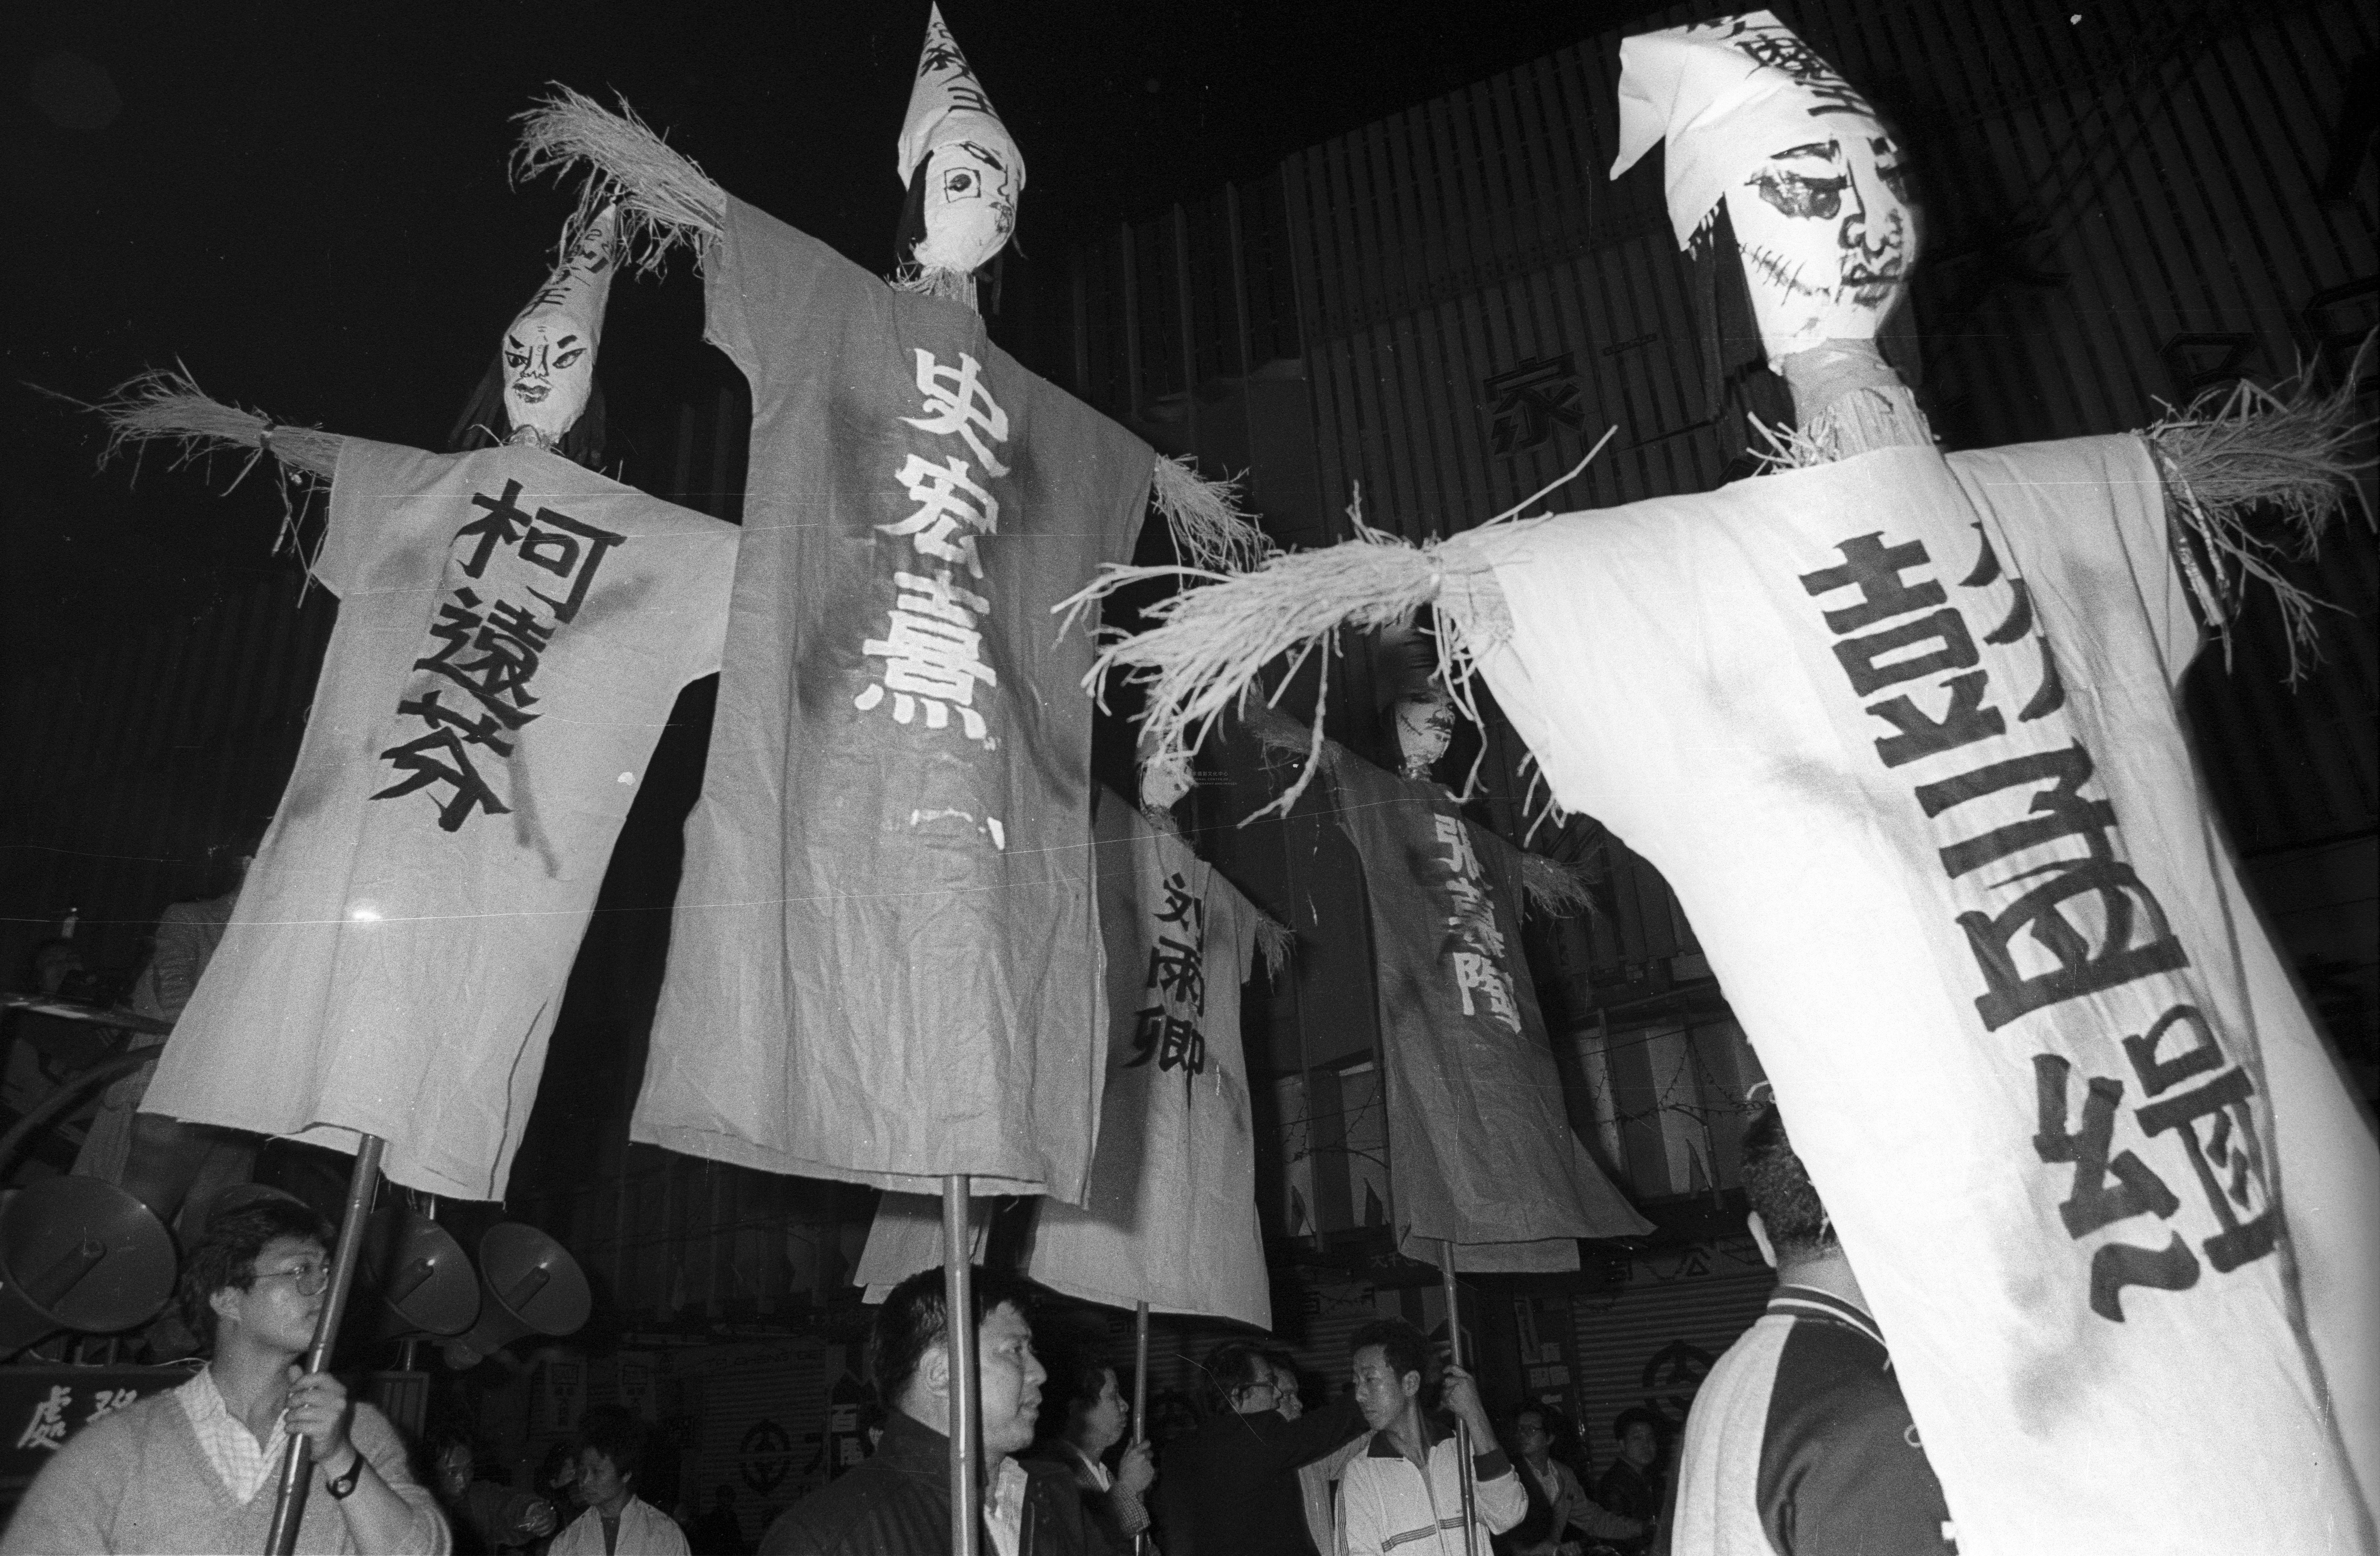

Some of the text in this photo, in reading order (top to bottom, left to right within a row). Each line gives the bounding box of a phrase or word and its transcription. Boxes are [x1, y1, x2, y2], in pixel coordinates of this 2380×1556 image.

[368, 478, 628, 832] 柯遠芬
[1799, 522, 2287, 1322] 彭孟緝
